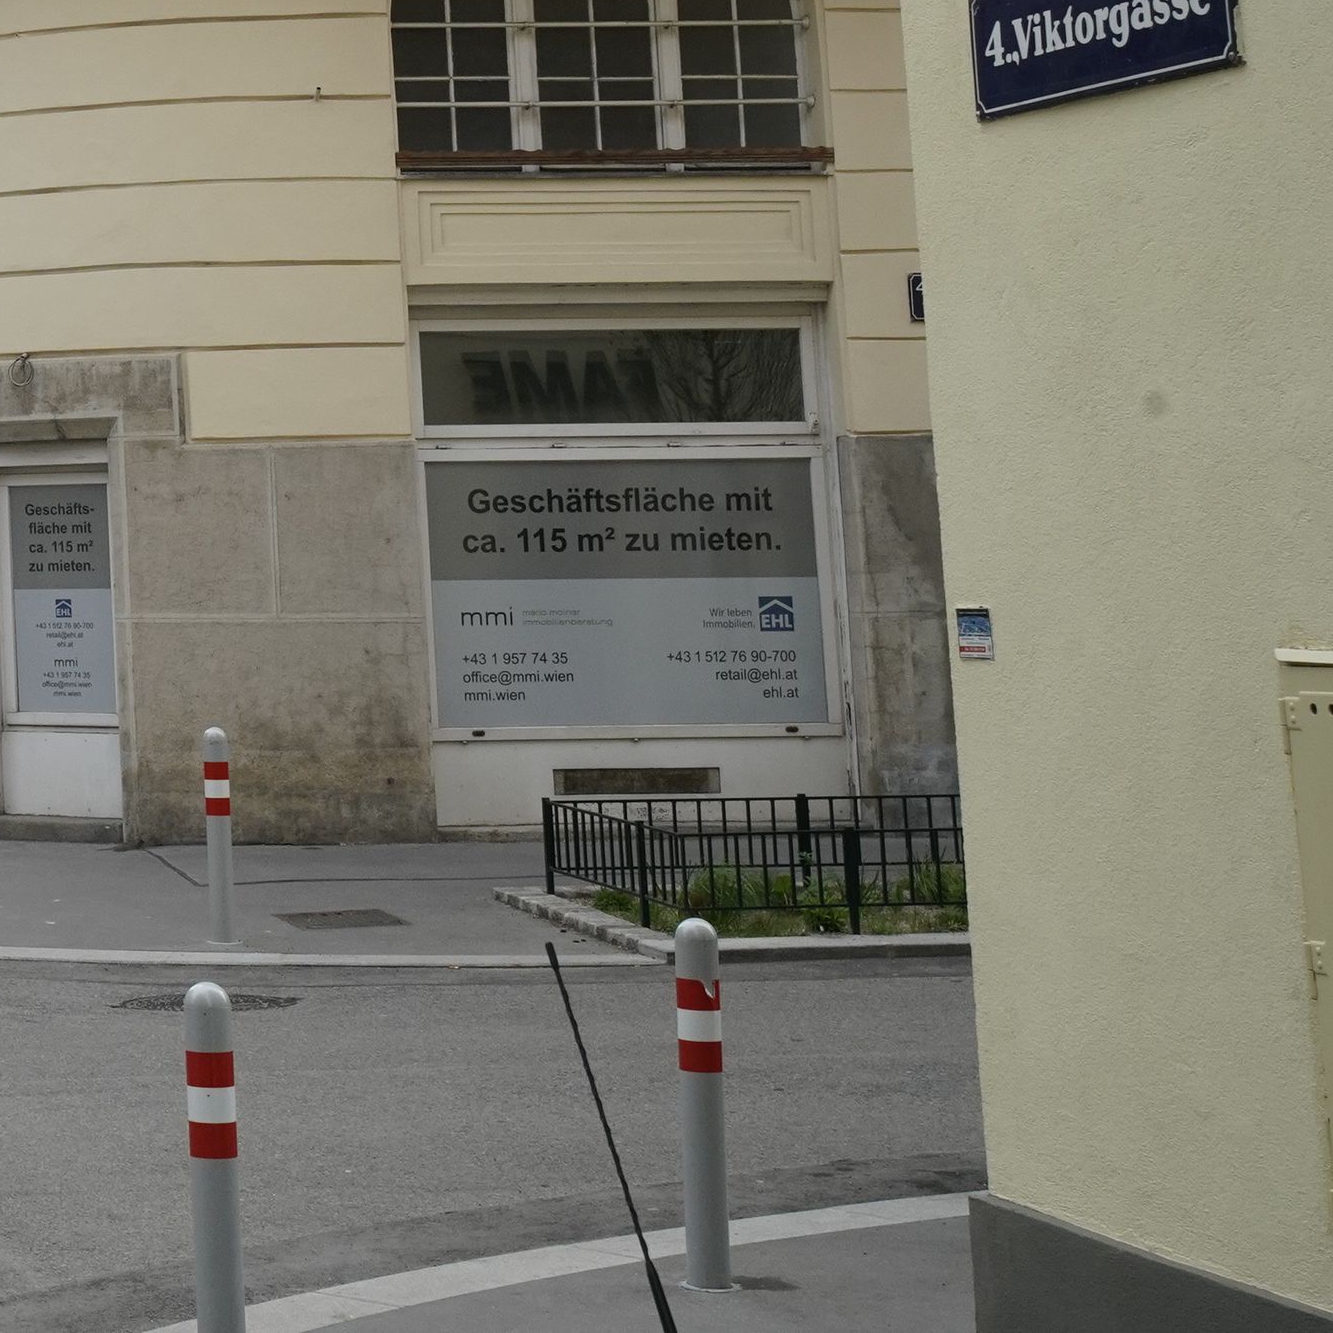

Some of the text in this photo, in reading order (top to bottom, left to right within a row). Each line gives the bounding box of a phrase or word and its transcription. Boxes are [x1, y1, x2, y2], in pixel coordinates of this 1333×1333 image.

[467, 486, 773, 514] Geschäftsfläche mit
[25, 502, 95, 517] Geschäfts-
[29, 522, 92, 535] fläche mit
[29, 540, 94, 554] ca. 115 m²
[462, 527, 781, 554] ca. 115 m² zu mieten.
[29, 559, 95, 573] zu mieten.
[56, 608, 72, 616] EHL
[461, 606, 514, 627] mmi
[709, 607, 752, 617] Wir leben
[702, 619, 756, 629] Immobilien.
[760, 614, 793, 629] EHL
[463, 651, 569, 665] +43 1 957 74 35
[667, 650, 797, 663] +43 1 512 76 90-700
[463, 669, 575, 686] office@mmi.wien
[715, 667, 798, 684] retail@ehl.at
[464, 688, 526, 702] mmi.wien
[763, 686, 800, 699] ehl.at
